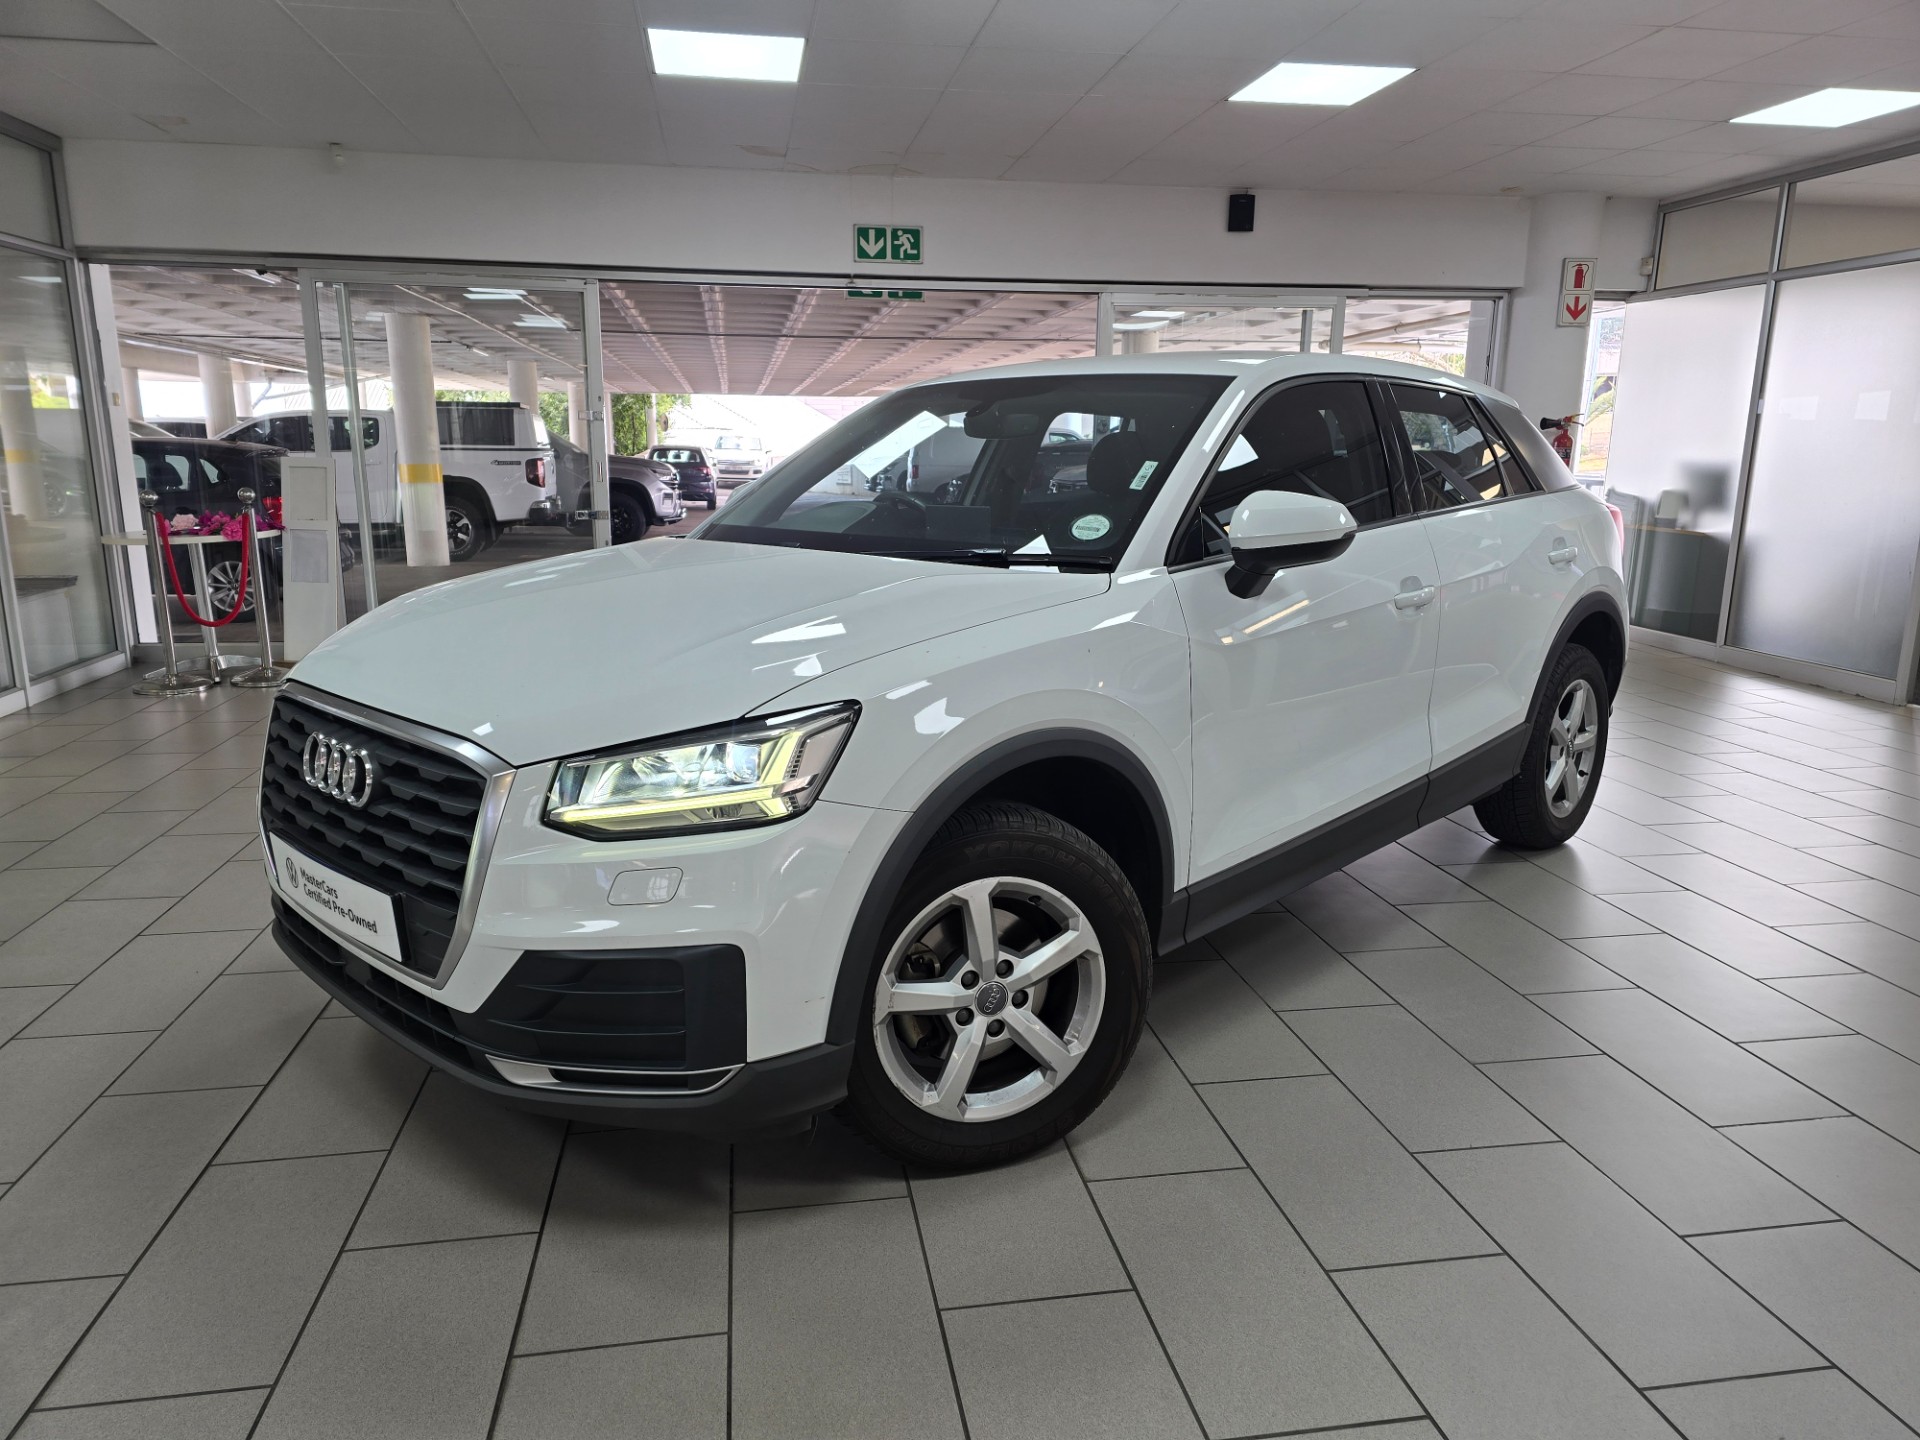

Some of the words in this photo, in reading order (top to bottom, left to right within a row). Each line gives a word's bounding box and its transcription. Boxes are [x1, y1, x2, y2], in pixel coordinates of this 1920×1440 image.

[300, 868, 338, 899] MasterCars
[304, 883, 332, 910] Certified
[333, 900, 378, 934] Pre-Owned
